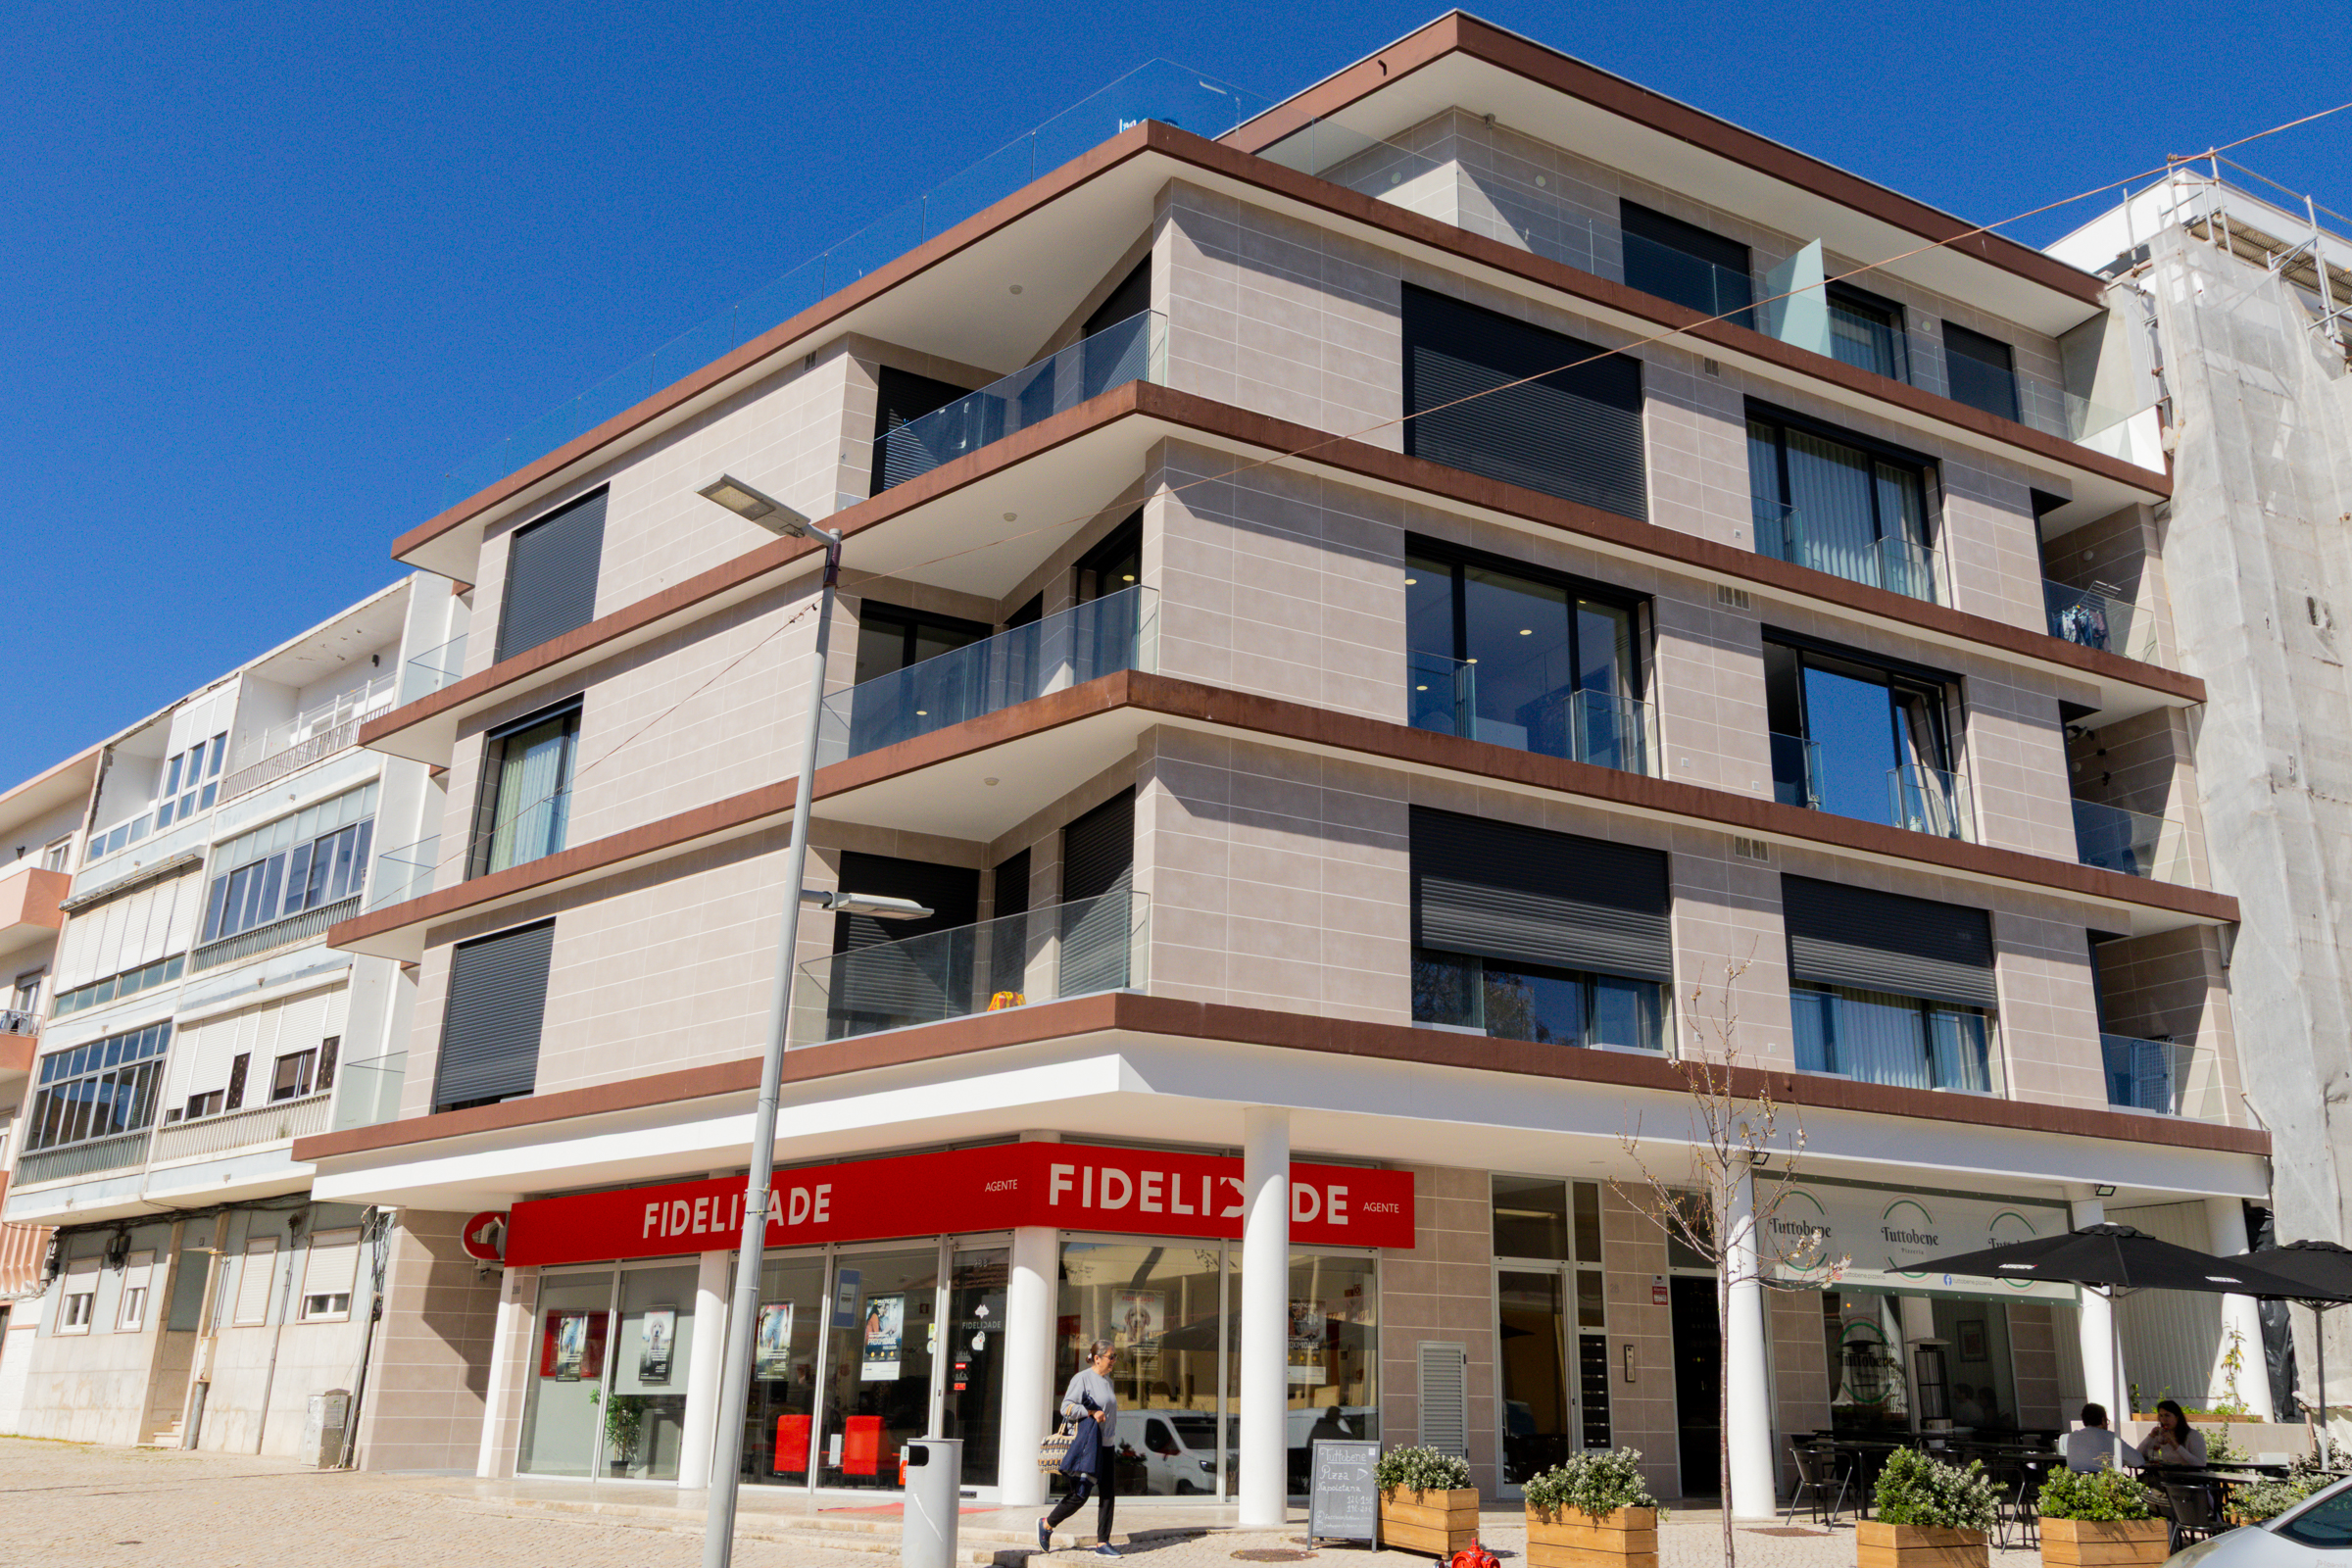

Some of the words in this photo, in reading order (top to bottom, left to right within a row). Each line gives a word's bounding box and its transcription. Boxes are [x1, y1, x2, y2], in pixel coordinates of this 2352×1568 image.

[985, 1179, 1018, 1193] AGENTE
[1049, 1162, 1348, 1225] FIDELIDDE
[642, 1183, 832, 1240] FIDELIADE
[1363, 1201, 1400, 1214] AGENTE
[1880, 1226, 1940, 1247] Tuttobene
[961, 1320, 1002, 1330] FIDELIDADE
[1318, 1446, 1367, 1462] Tuttobene
[1319, 1464, 1349, 1480] Pizza
[1316, 1481, 1362, 1494] Napoletana
